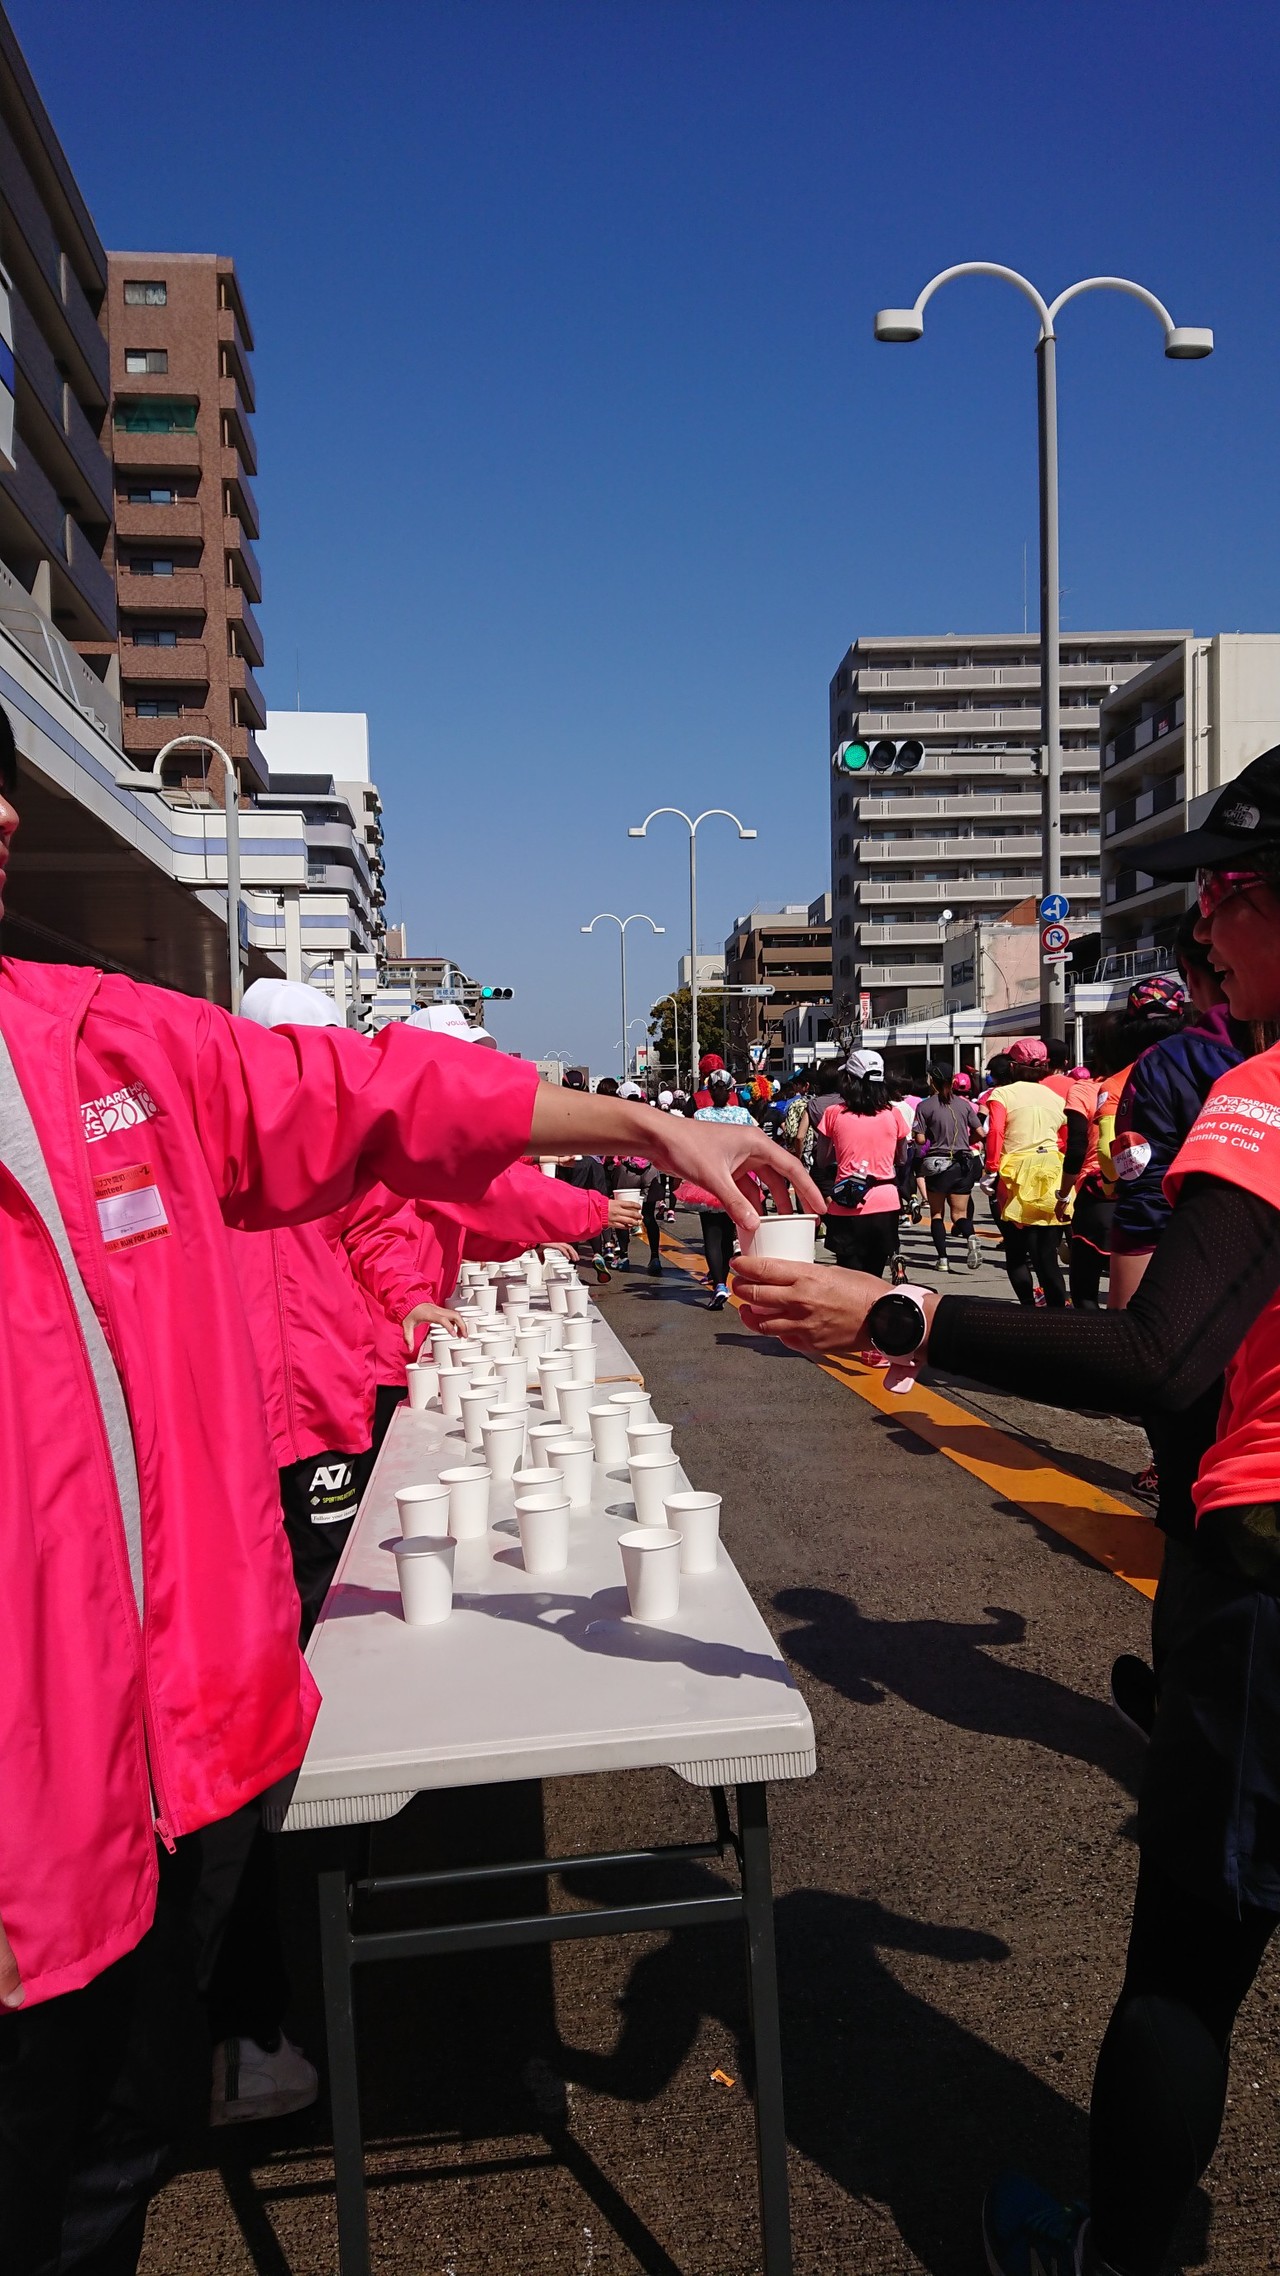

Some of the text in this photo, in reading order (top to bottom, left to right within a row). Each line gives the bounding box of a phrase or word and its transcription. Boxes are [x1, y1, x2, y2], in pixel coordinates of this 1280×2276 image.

[98, 1089, 160, 1133] 2018
[1240, 1097, 1280, 1114] MARATHO
[1219, 1121, 1265, 1140] Official
[1231, 1137, 1260, 1153] Club
[120, 1238, 133, 1248] RUN
[134, 1234, 146, 1244] FOR
[147, 1228, 168, 1239] JAPAN
